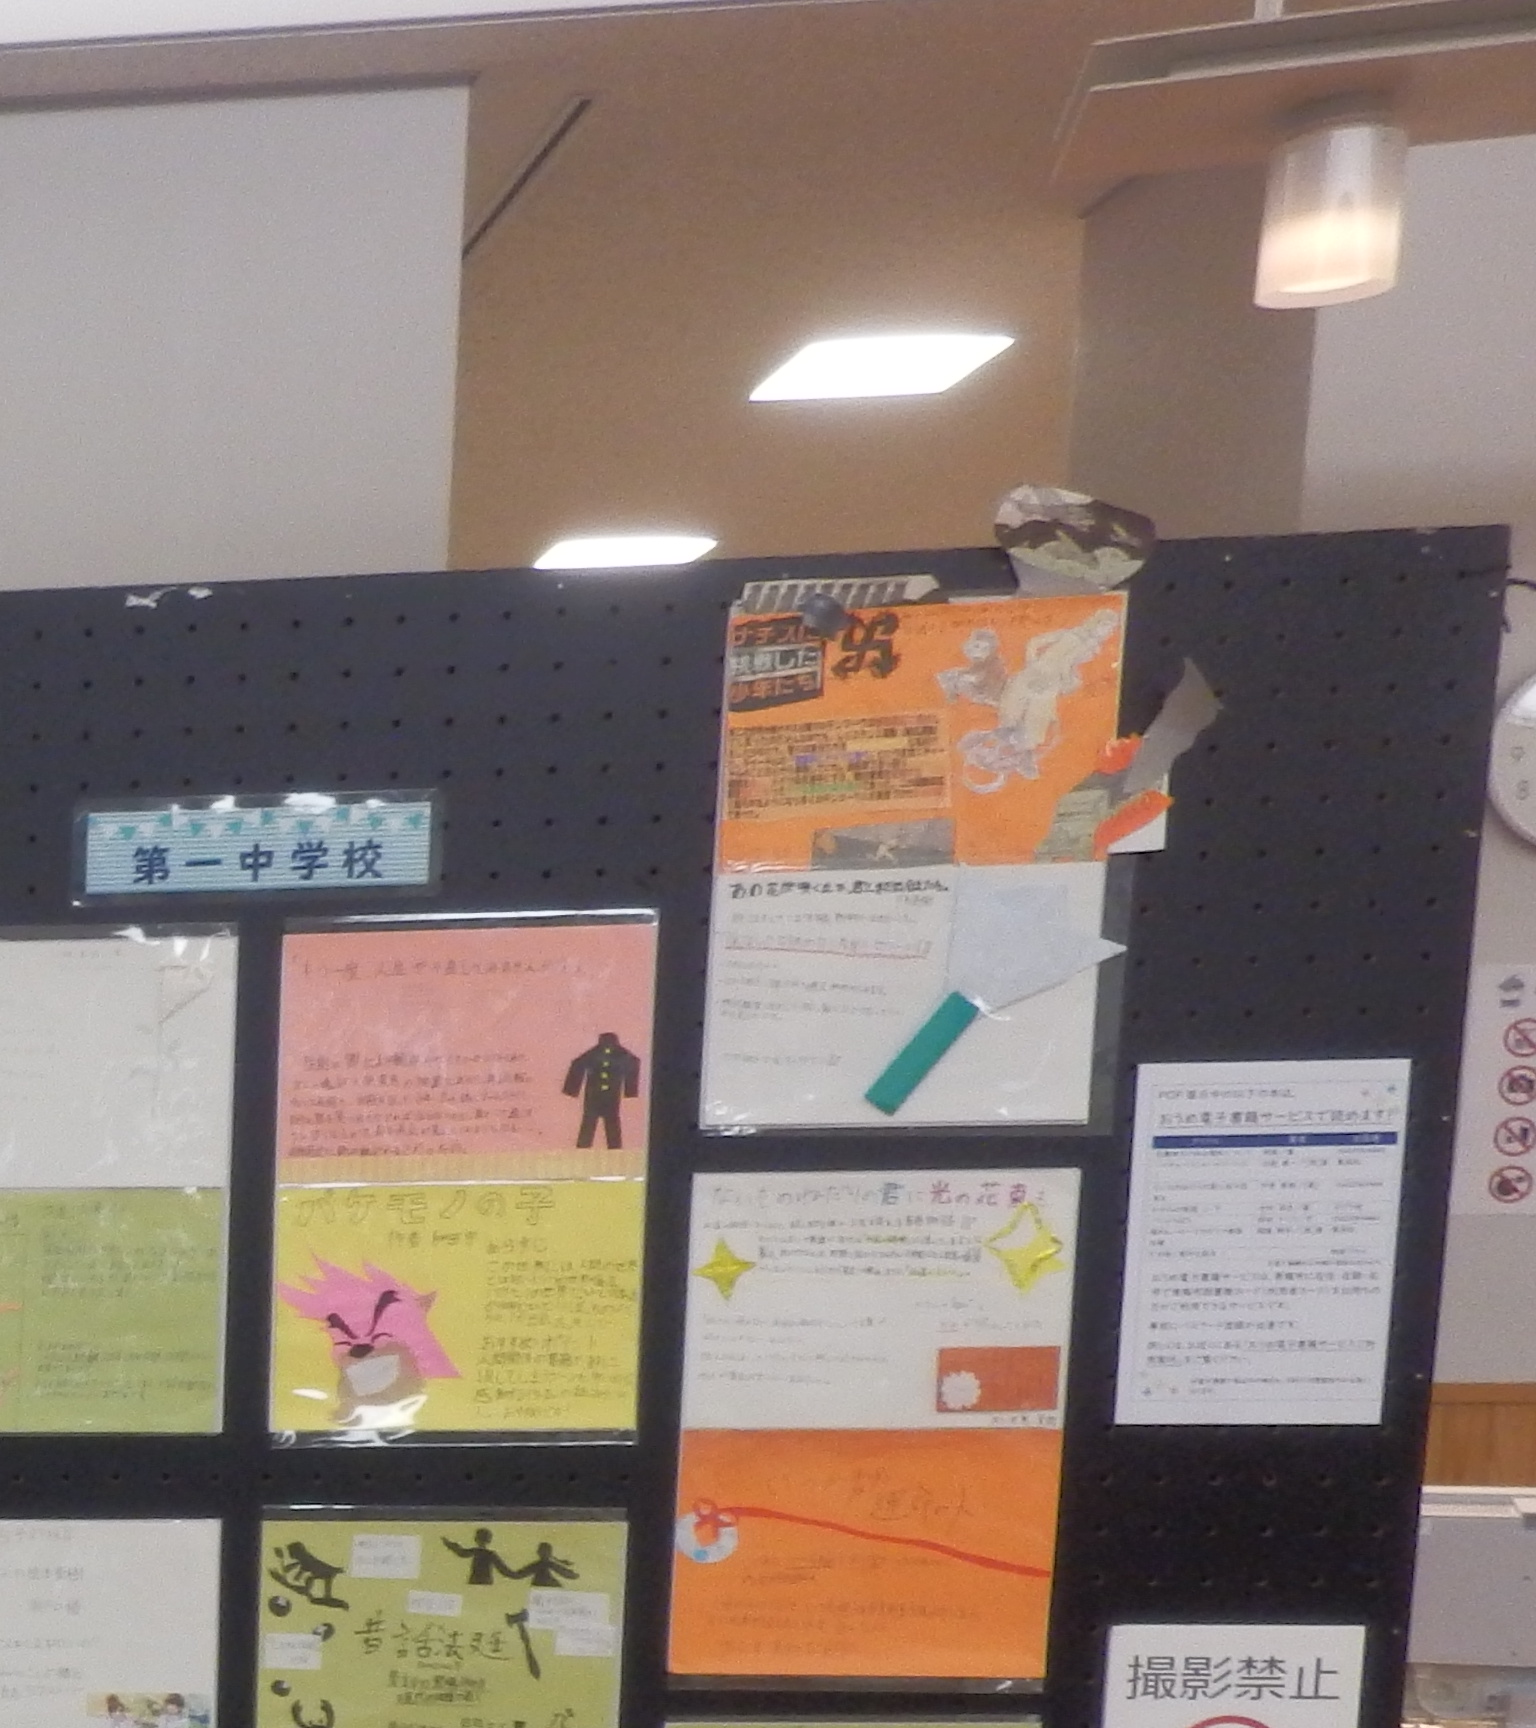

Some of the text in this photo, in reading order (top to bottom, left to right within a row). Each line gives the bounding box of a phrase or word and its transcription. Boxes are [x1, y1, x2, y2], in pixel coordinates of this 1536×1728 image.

[131, 843, 388, 886] 第一中学校
[1125, 1654, 1341, 1701] 撮影禁止
